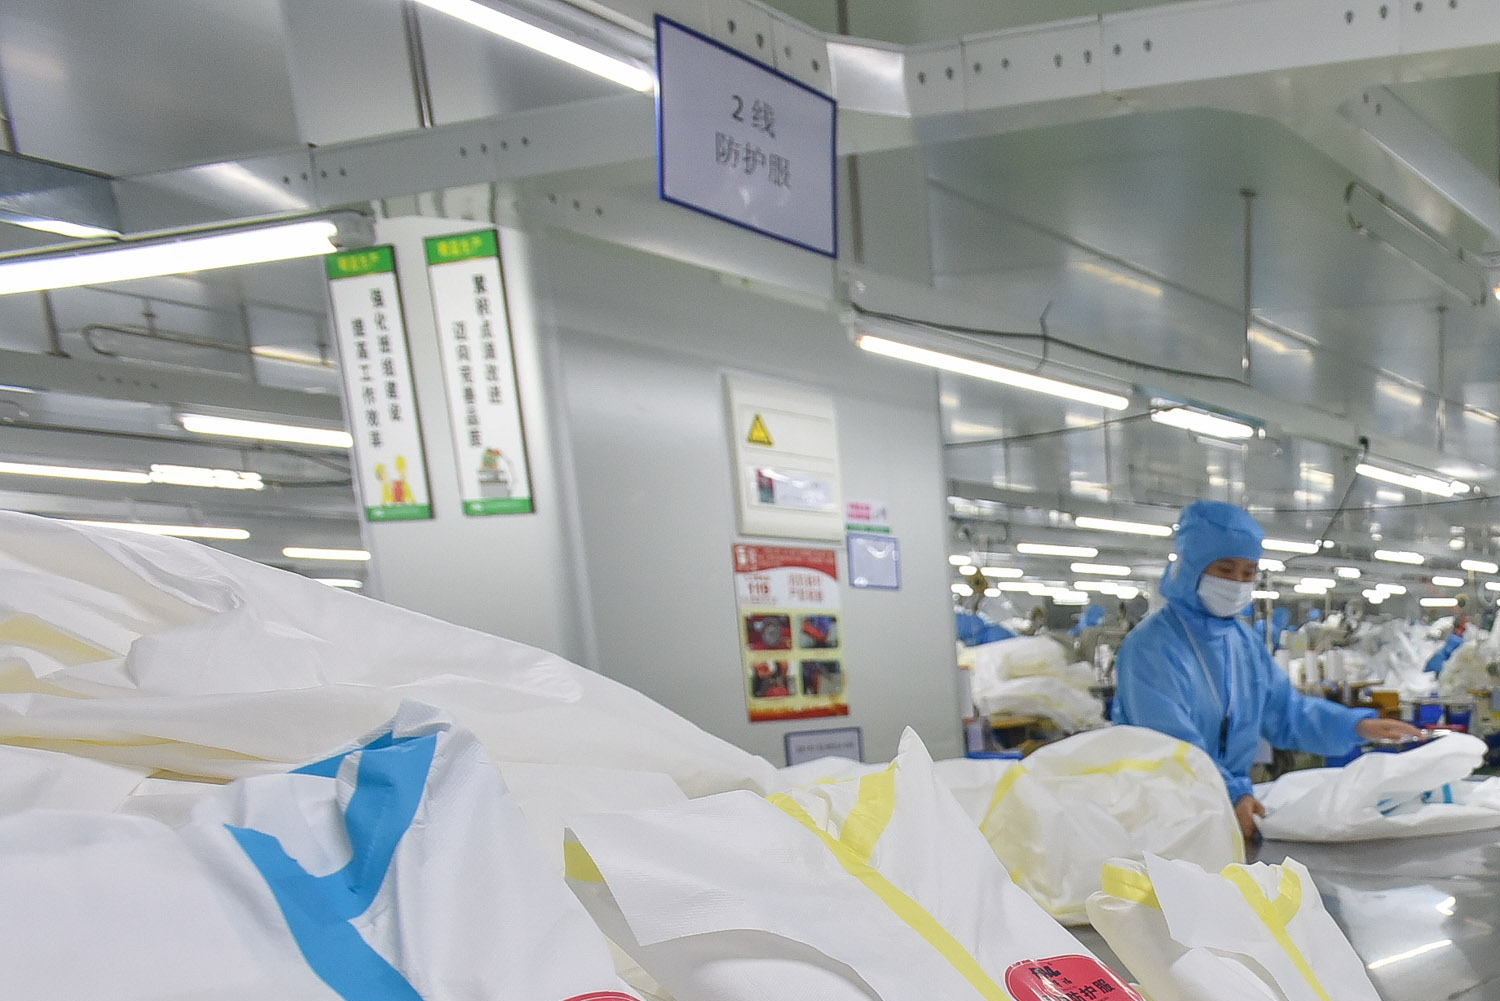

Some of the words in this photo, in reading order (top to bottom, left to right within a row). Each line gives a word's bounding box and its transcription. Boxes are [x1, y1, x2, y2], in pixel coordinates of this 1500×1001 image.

[714, 130, 792, 189] 防护服
[350, 317, 383, 449] 提高工作效率
